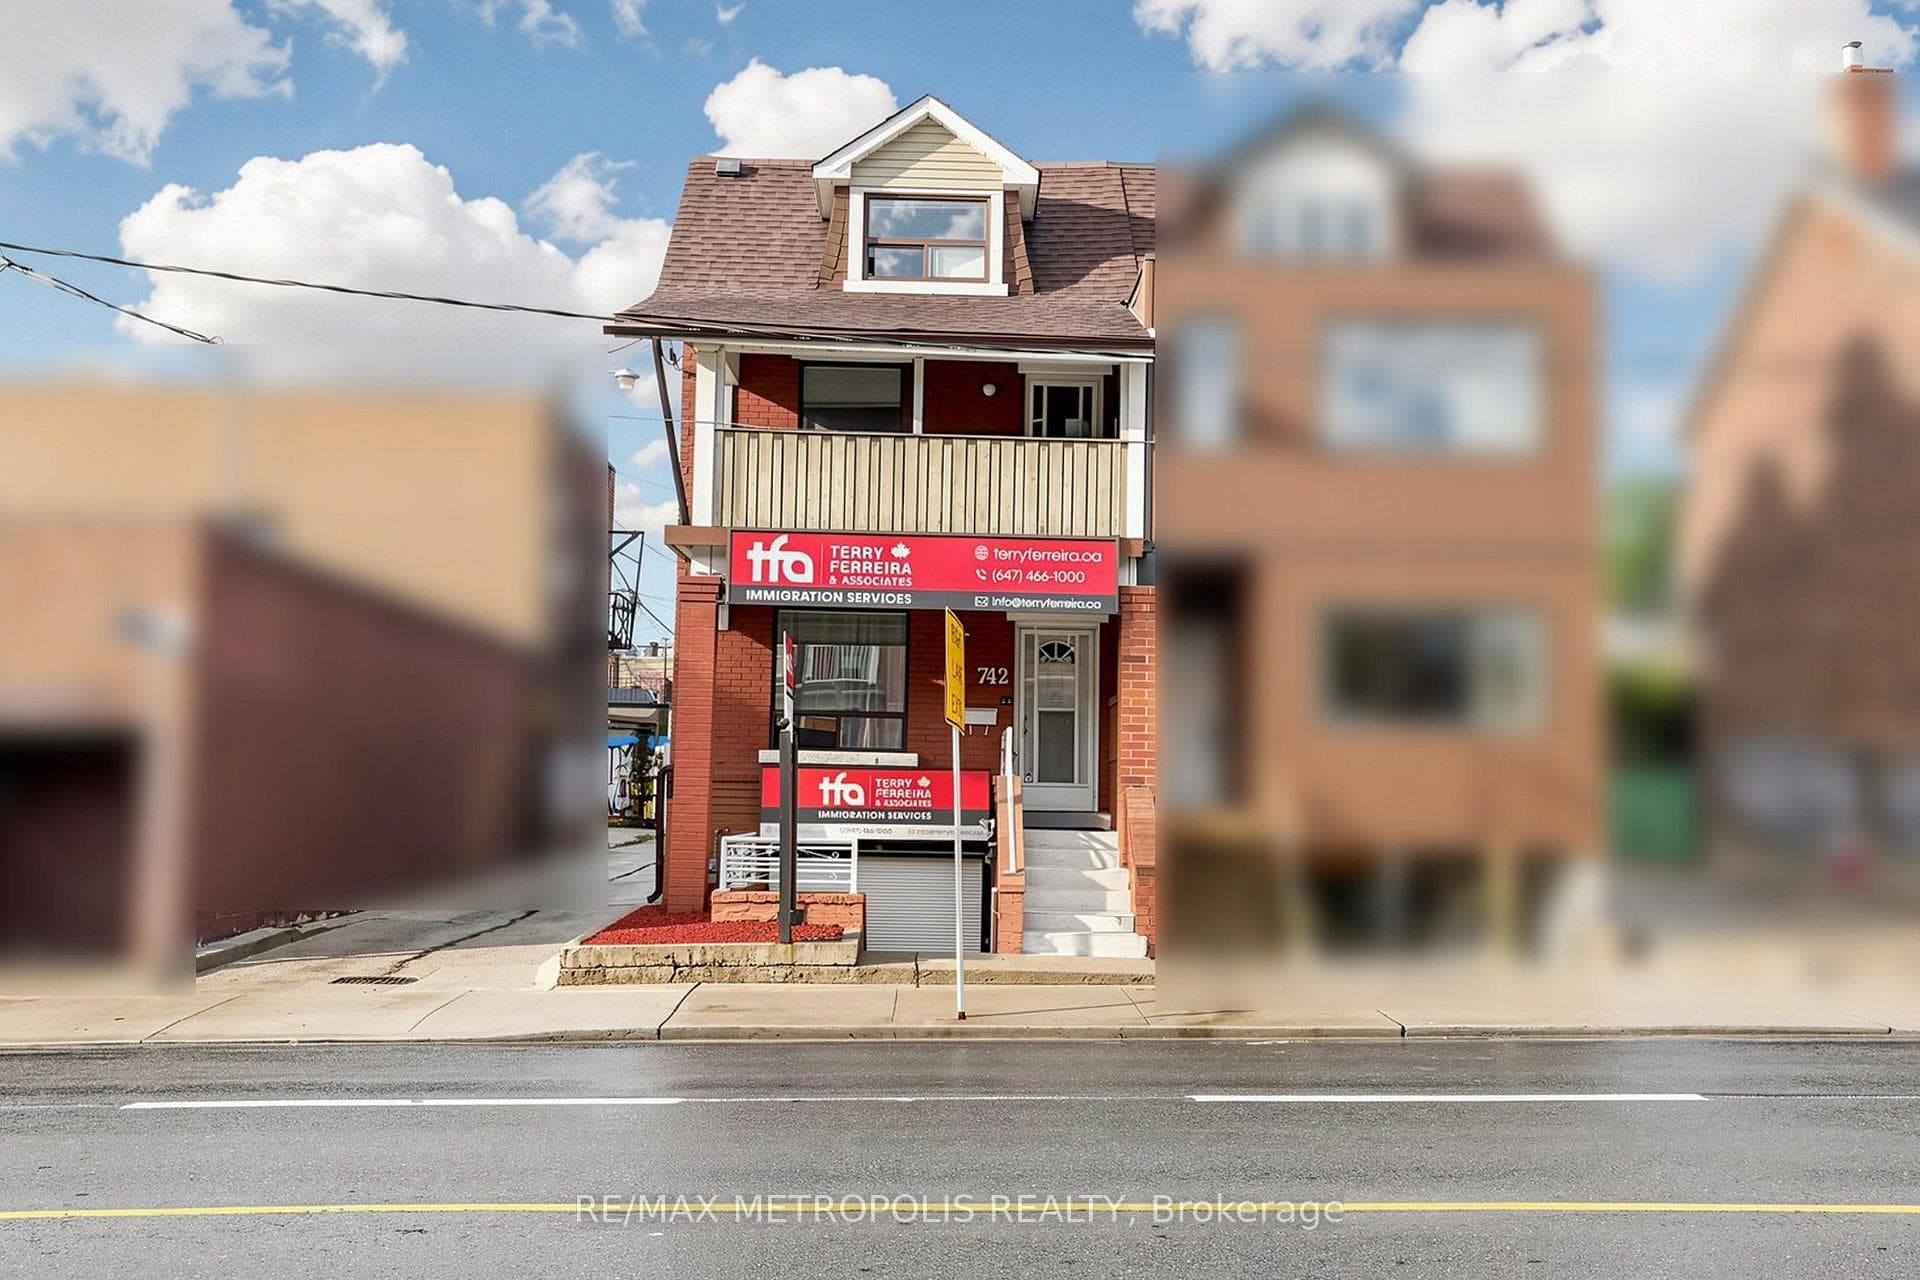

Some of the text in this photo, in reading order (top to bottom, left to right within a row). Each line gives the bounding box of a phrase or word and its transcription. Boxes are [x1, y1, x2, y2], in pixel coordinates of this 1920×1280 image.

[746, 533, 814, 583] tfa
[830, 545, 884, 560] TERRY
[829, 560, 912, 575] FERREIRA
[829, 575, 913, 587] & ASSOCIATES
[992, 568, 1086, 584] (647) 466-1000
[745, 589, 912, 605] IMMIGRATION SERVICES
[977, 666, 1009, 685] 742
[818, 771, 865, 806] tfa
[875, 778, 913, 788] TERRY
[875, 788, 932, 799] FERREIRA
[818, 810, 932, 820] IMMIGRATION SERVICES
